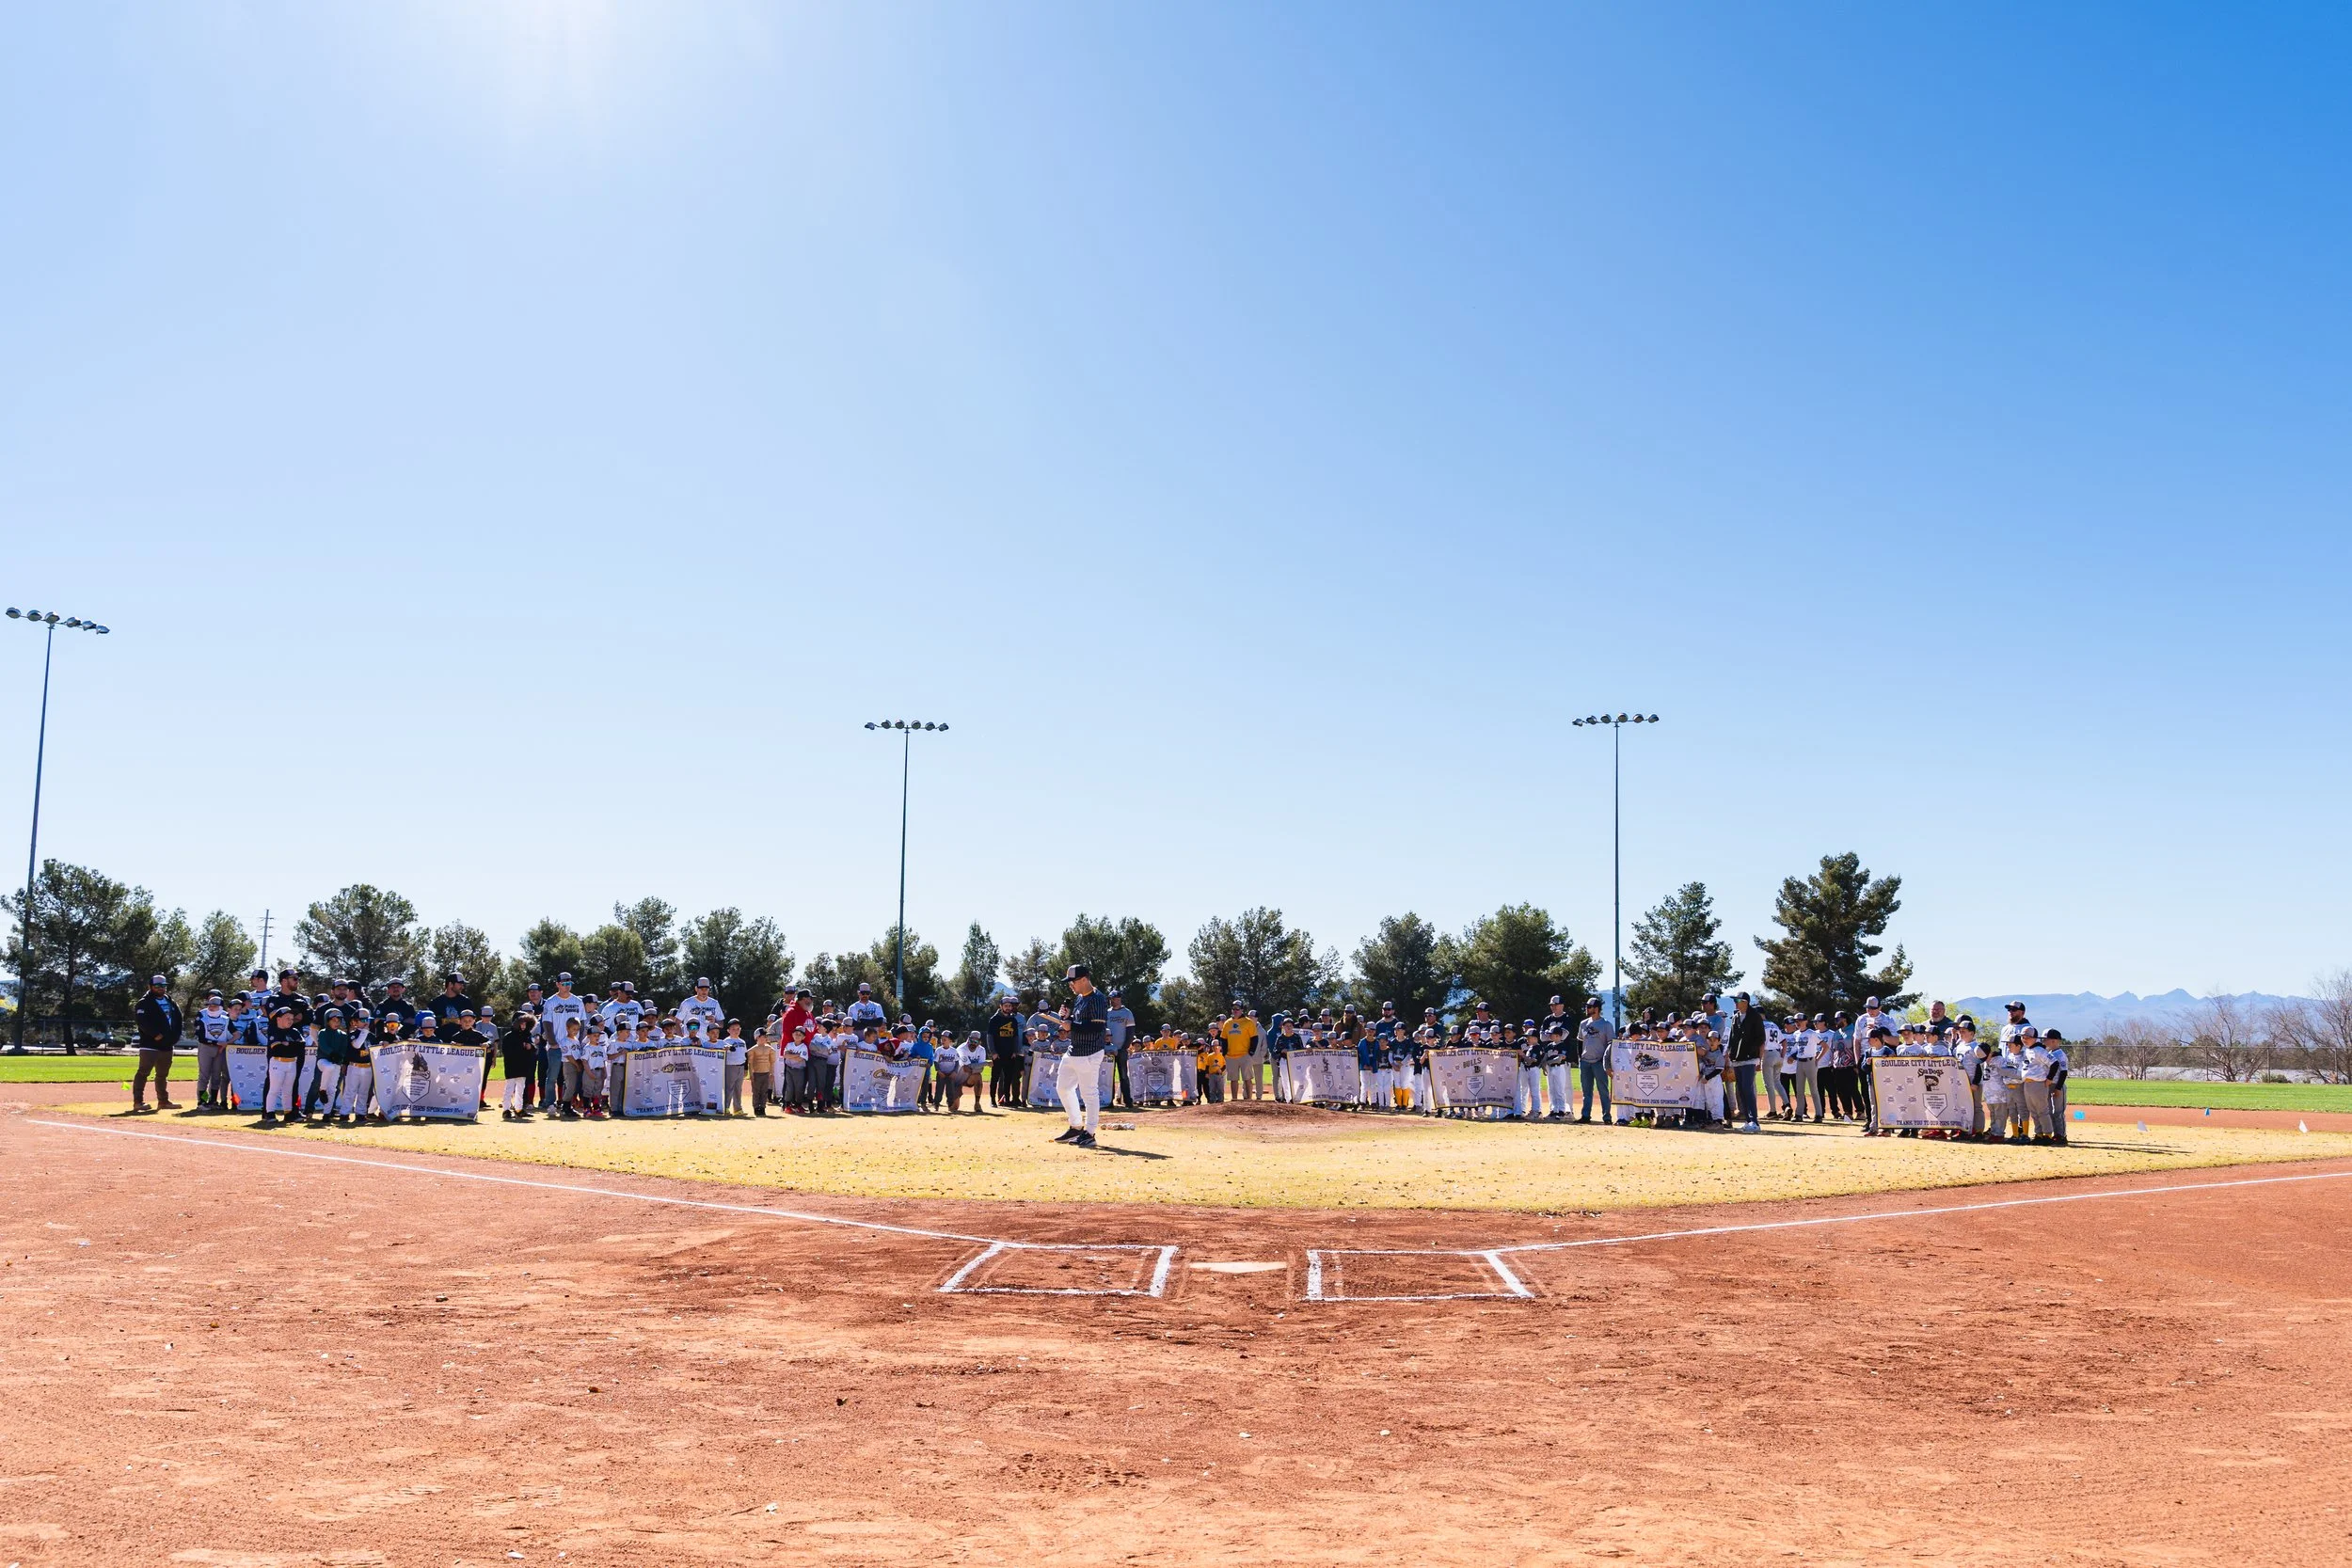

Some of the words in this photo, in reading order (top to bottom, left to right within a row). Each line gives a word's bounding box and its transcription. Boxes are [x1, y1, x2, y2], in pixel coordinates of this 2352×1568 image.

[380, 1045, 402, 1056] BOULDE
[419, 1045, 445, 1054] LITTLE
[446, 1048, 474, 1056] LEAGUE
[658, 1049, 671, 1058] CITY
[694, 1049, 716, 1058] LEAGUE
[1463, 1057, 1482, 1068] BULLS
